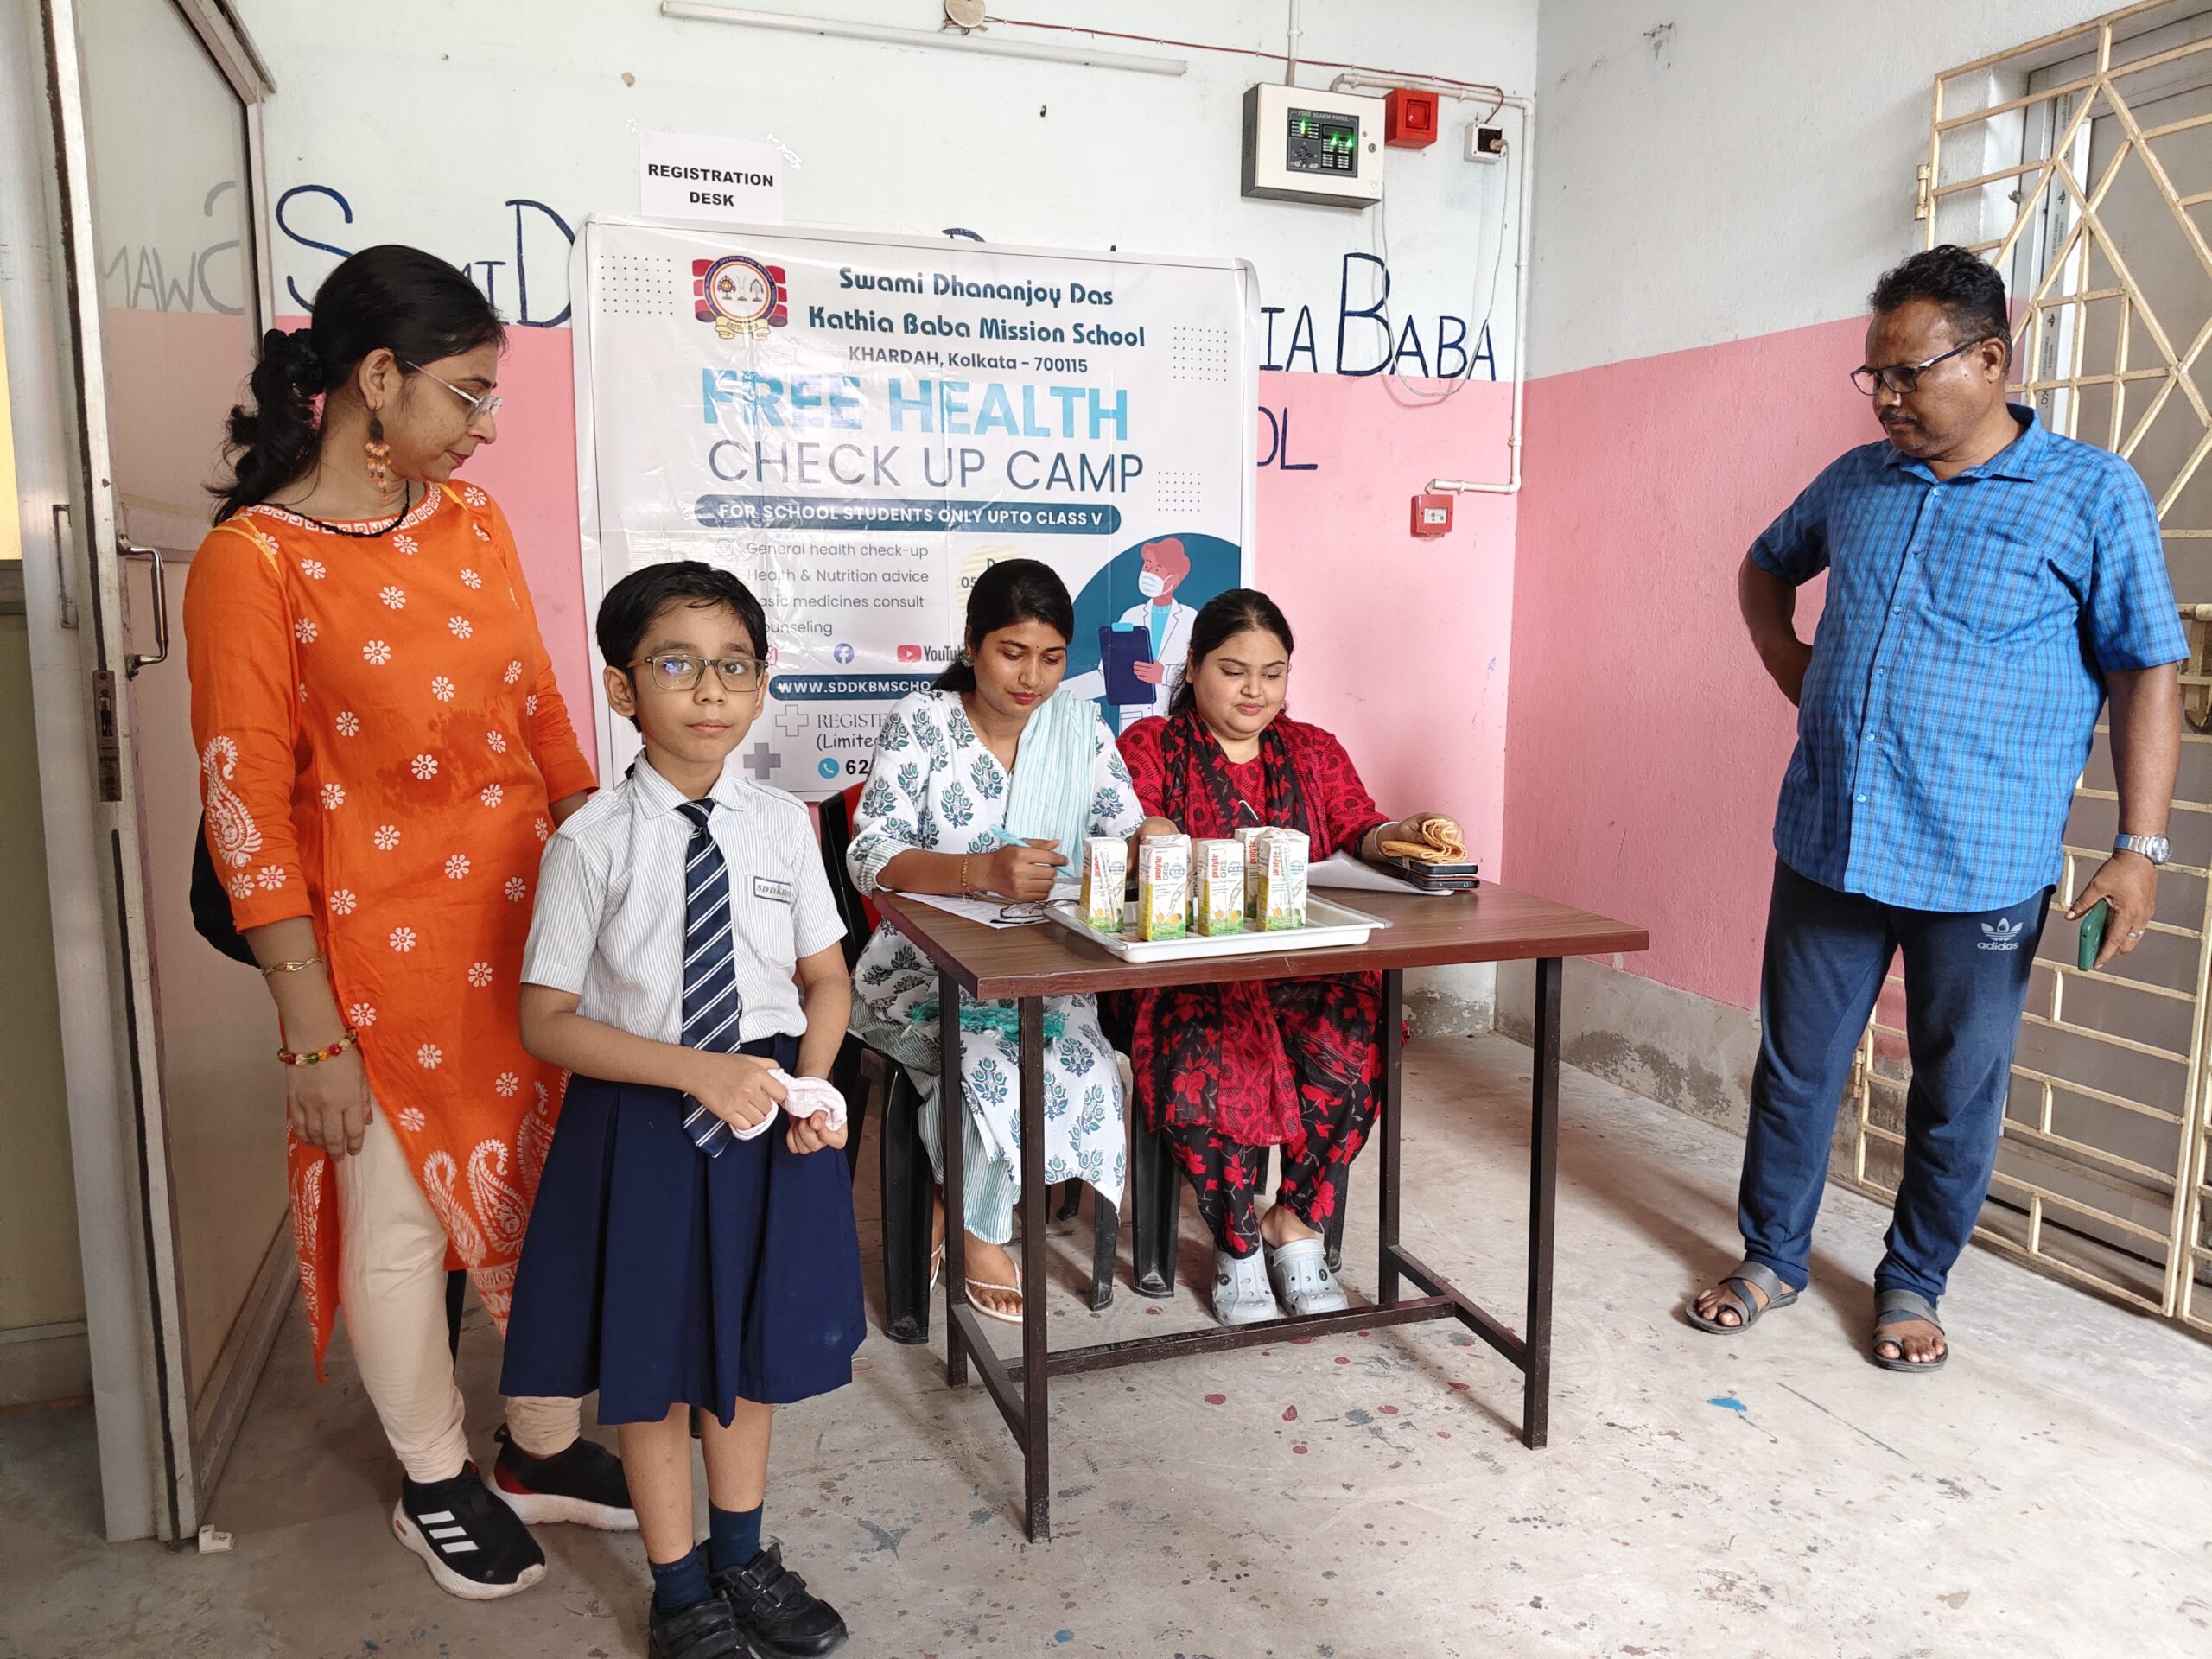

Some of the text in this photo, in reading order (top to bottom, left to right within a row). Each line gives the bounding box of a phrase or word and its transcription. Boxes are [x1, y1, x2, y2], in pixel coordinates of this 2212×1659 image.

[648, 163, 774, 187] REGISTRATION
[690, 191, 734, 207] DESK
[839, 266, 1114, 308] Swami Dhananjoy Das
[809, 305, 1145, 347] Kathia Baba Mission School
[1336, 252, 1497, 382] BABA
[849, 346, 944, 368] KHARDAH,
[948, 353, 1017, 370] Kolkata
[1034, 357, 1088, 373] 700115
[702, 367, 1128, 442] FREE HEALTH
[709, 439, 1144, 493] CHECK UP CAMP
[719, 504, 1103, 526] FOR SCHOOL STUDENTS ONLY UPTO CLASS V
[747, 543, 929, 558] General health check-up
[800, 569, 812, 582] &
[817, 569, 878, 582] Nutrition
[881, 569, 929, 583] advice
[758, 595, 925, 608] asic medicines consult
[765, 620, 833, 637] ounseling
[923, 645, 960, 662] YouTu
[778, 681, 935, 694] WWW.SDDKBMSCHO
[1977, 941, 2019, 951] adidas
